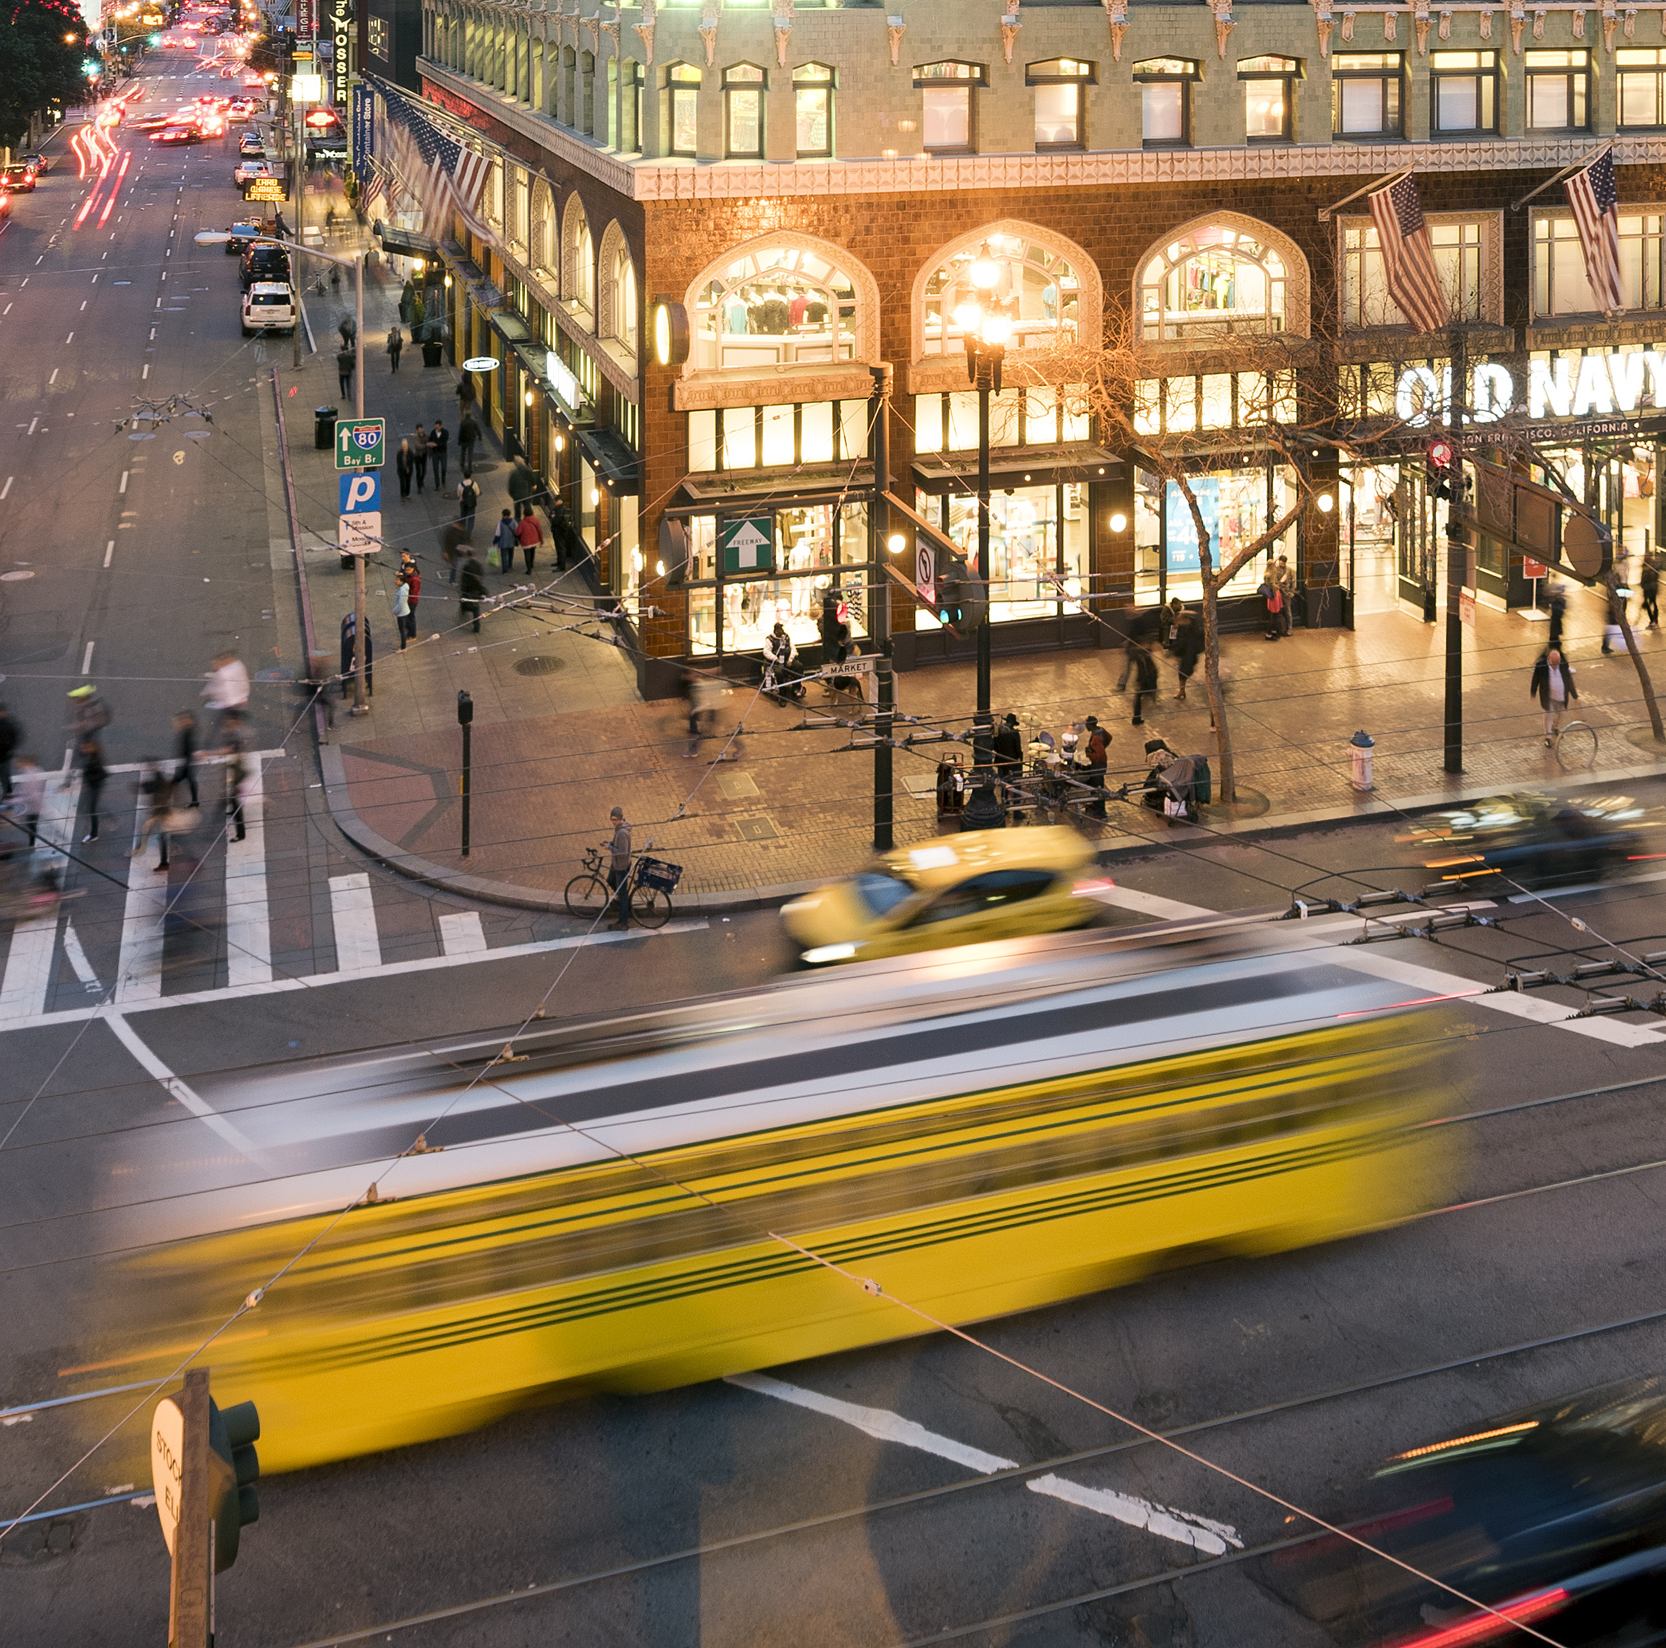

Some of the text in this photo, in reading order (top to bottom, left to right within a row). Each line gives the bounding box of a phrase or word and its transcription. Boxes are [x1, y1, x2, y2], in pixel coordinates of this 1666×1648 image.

[363, 97, 371, 120] Store
[1395, 363, 1514, 428] OLD
[358, 432, 377, 446] 80
[343, 453, 376, 466] Bay Br
[733, 537, 763, 546] FREEWAY
[830, 662, 867, 674] MARKET
